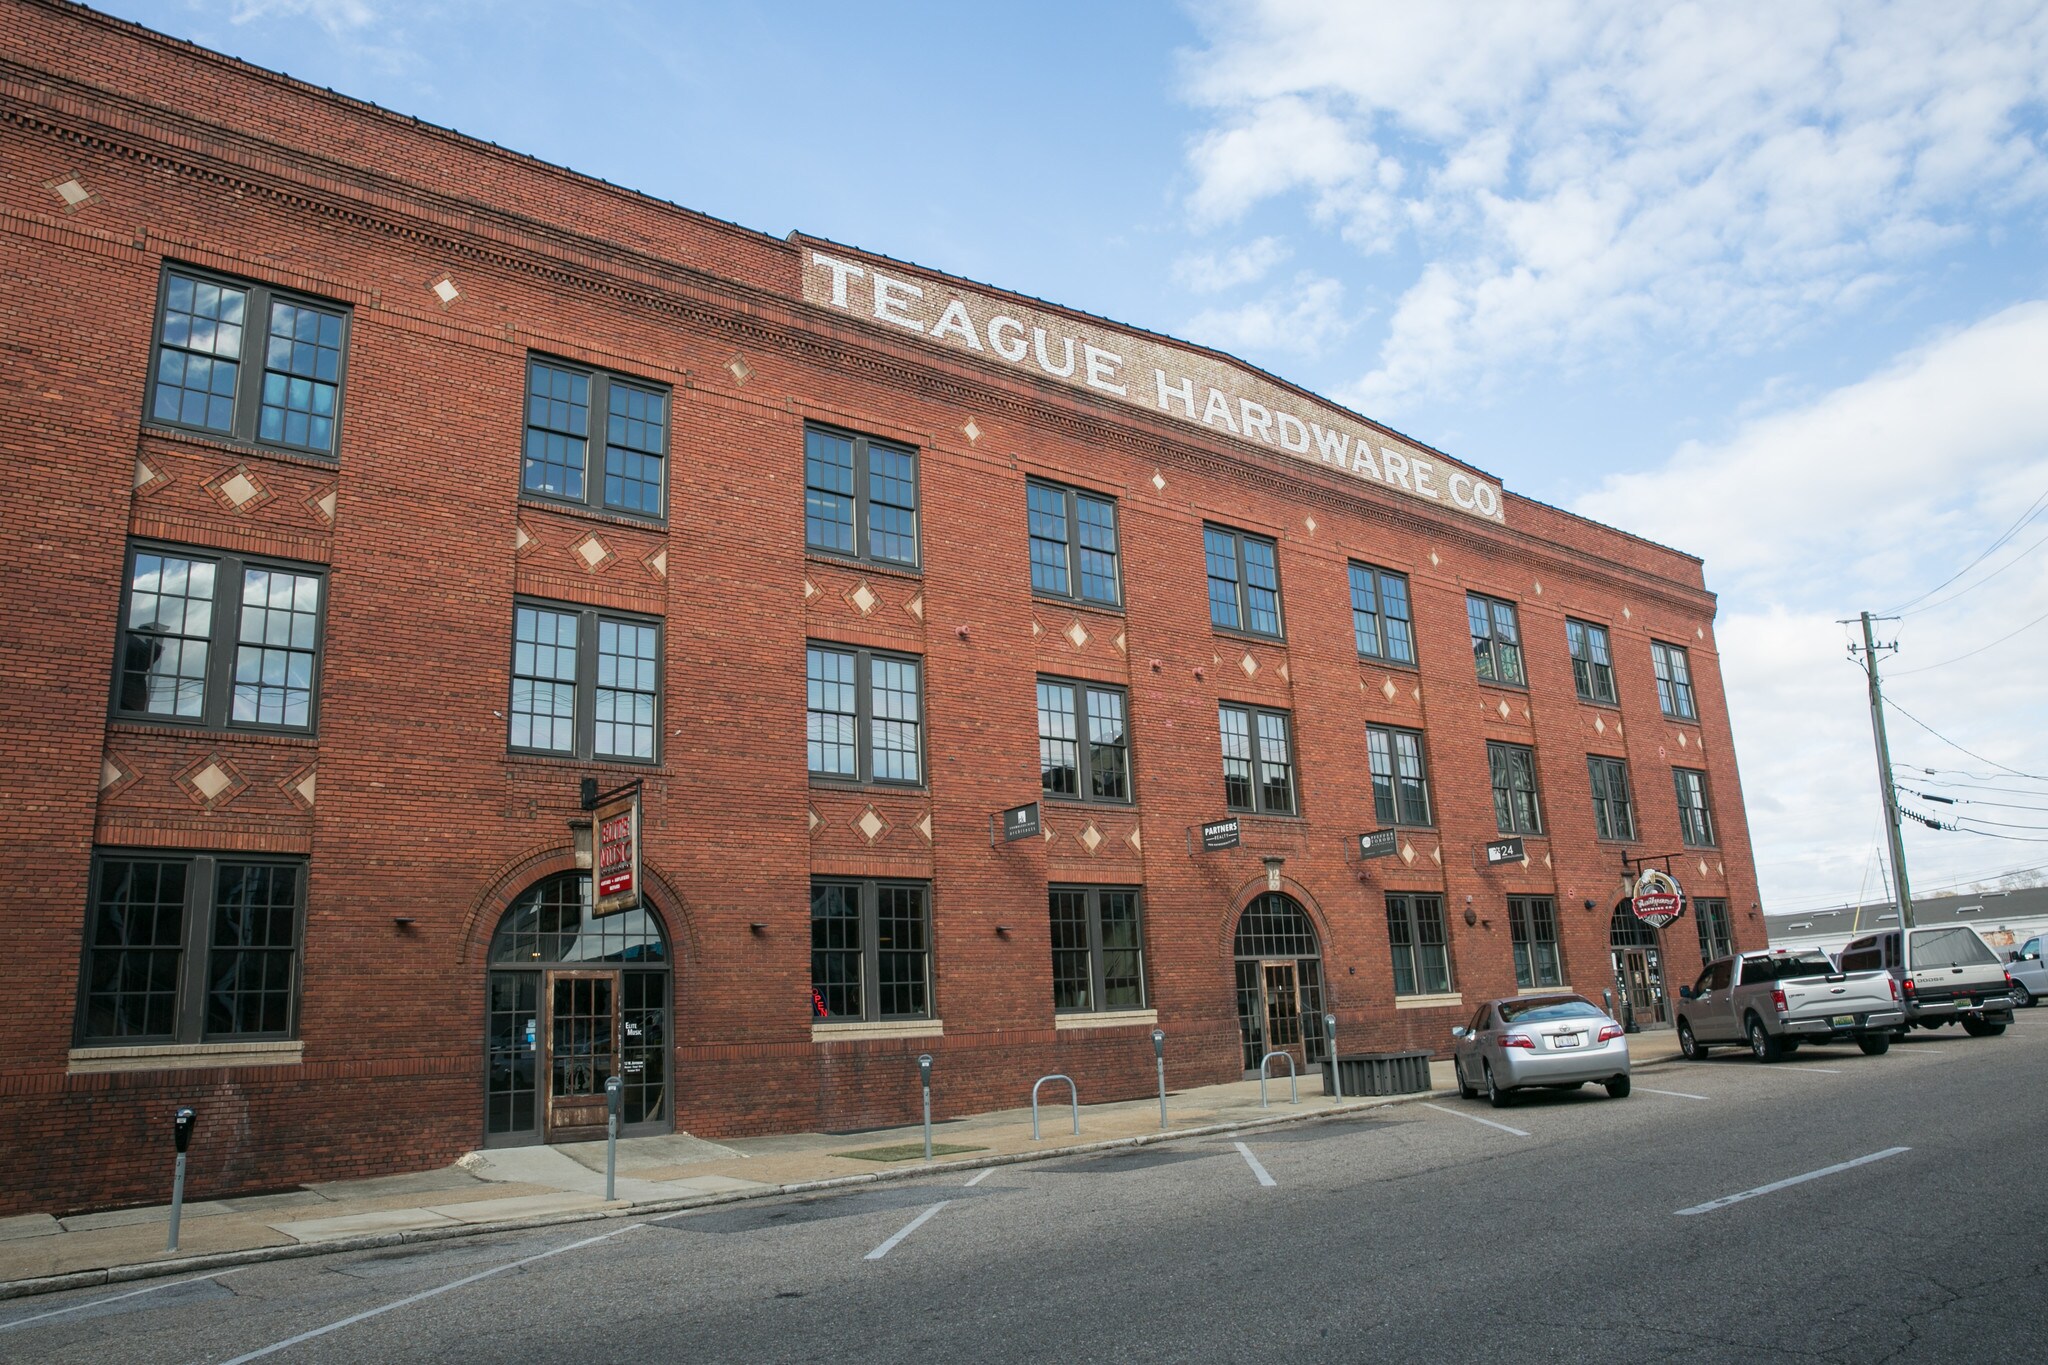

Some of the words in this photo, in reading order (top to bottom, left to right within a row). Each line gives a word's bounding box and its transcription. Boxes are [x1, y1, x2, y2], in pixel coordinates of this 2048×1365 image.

[812, 253, 1127, 397] TEAGUE
[1155, 369, 1438, 499] HARDWARE
[602, 816, 630, 844] ELITE
[1204, 822, 1237, 836] PARTNERS
[1214, 833, 1229, 841] REALTY
[600, 840, 632, 868] MUSIC
[1501, 845, 1514, 856] 24
[1268, 869, 1280, 879] 12
[1637, 897, 1675, 908] Railyard
[812, 988, 828, 1017] OPEN
